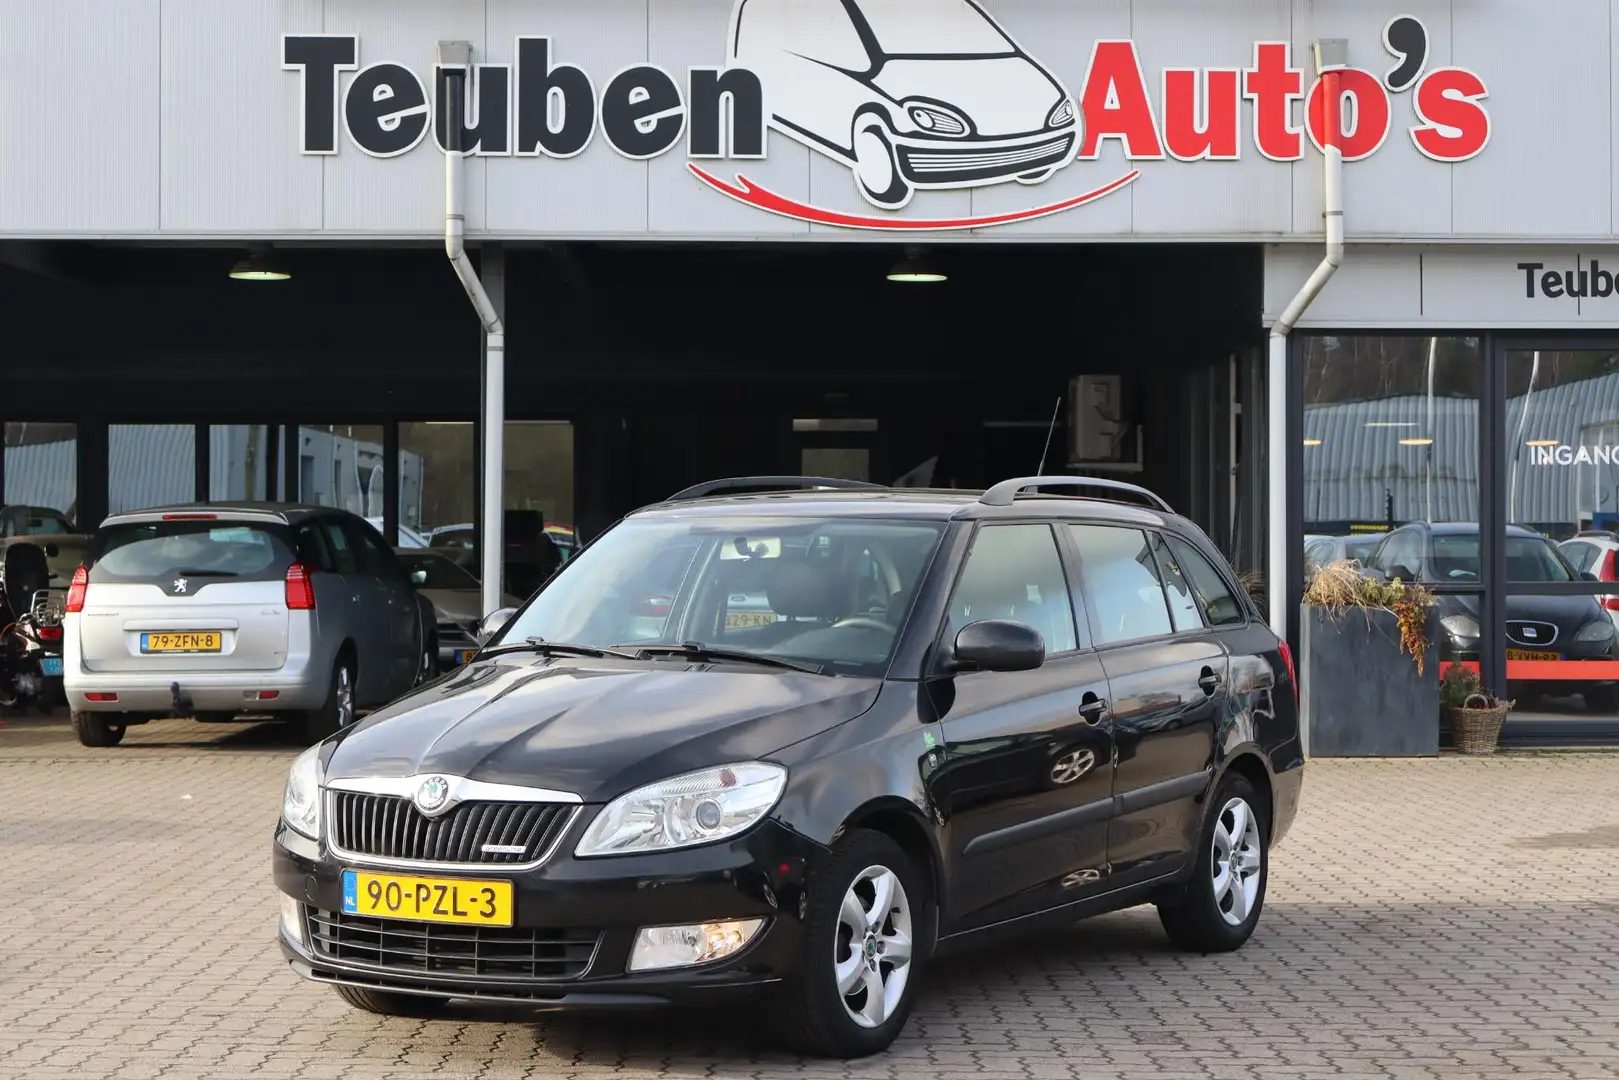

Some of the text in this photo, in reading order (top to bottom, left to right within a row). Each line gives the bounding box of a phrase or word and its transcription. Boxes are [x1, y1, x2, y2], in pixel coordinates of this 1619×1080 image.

[284, 16, 1490, 159] Teuben Auto's
[1517, 260, 1619, 298] Teub
[152, 635, 214, 648] 79-ZFN-8
[345, 896, 355, 906] NL
[367, 879, 497, 919] 90-PZL-3
